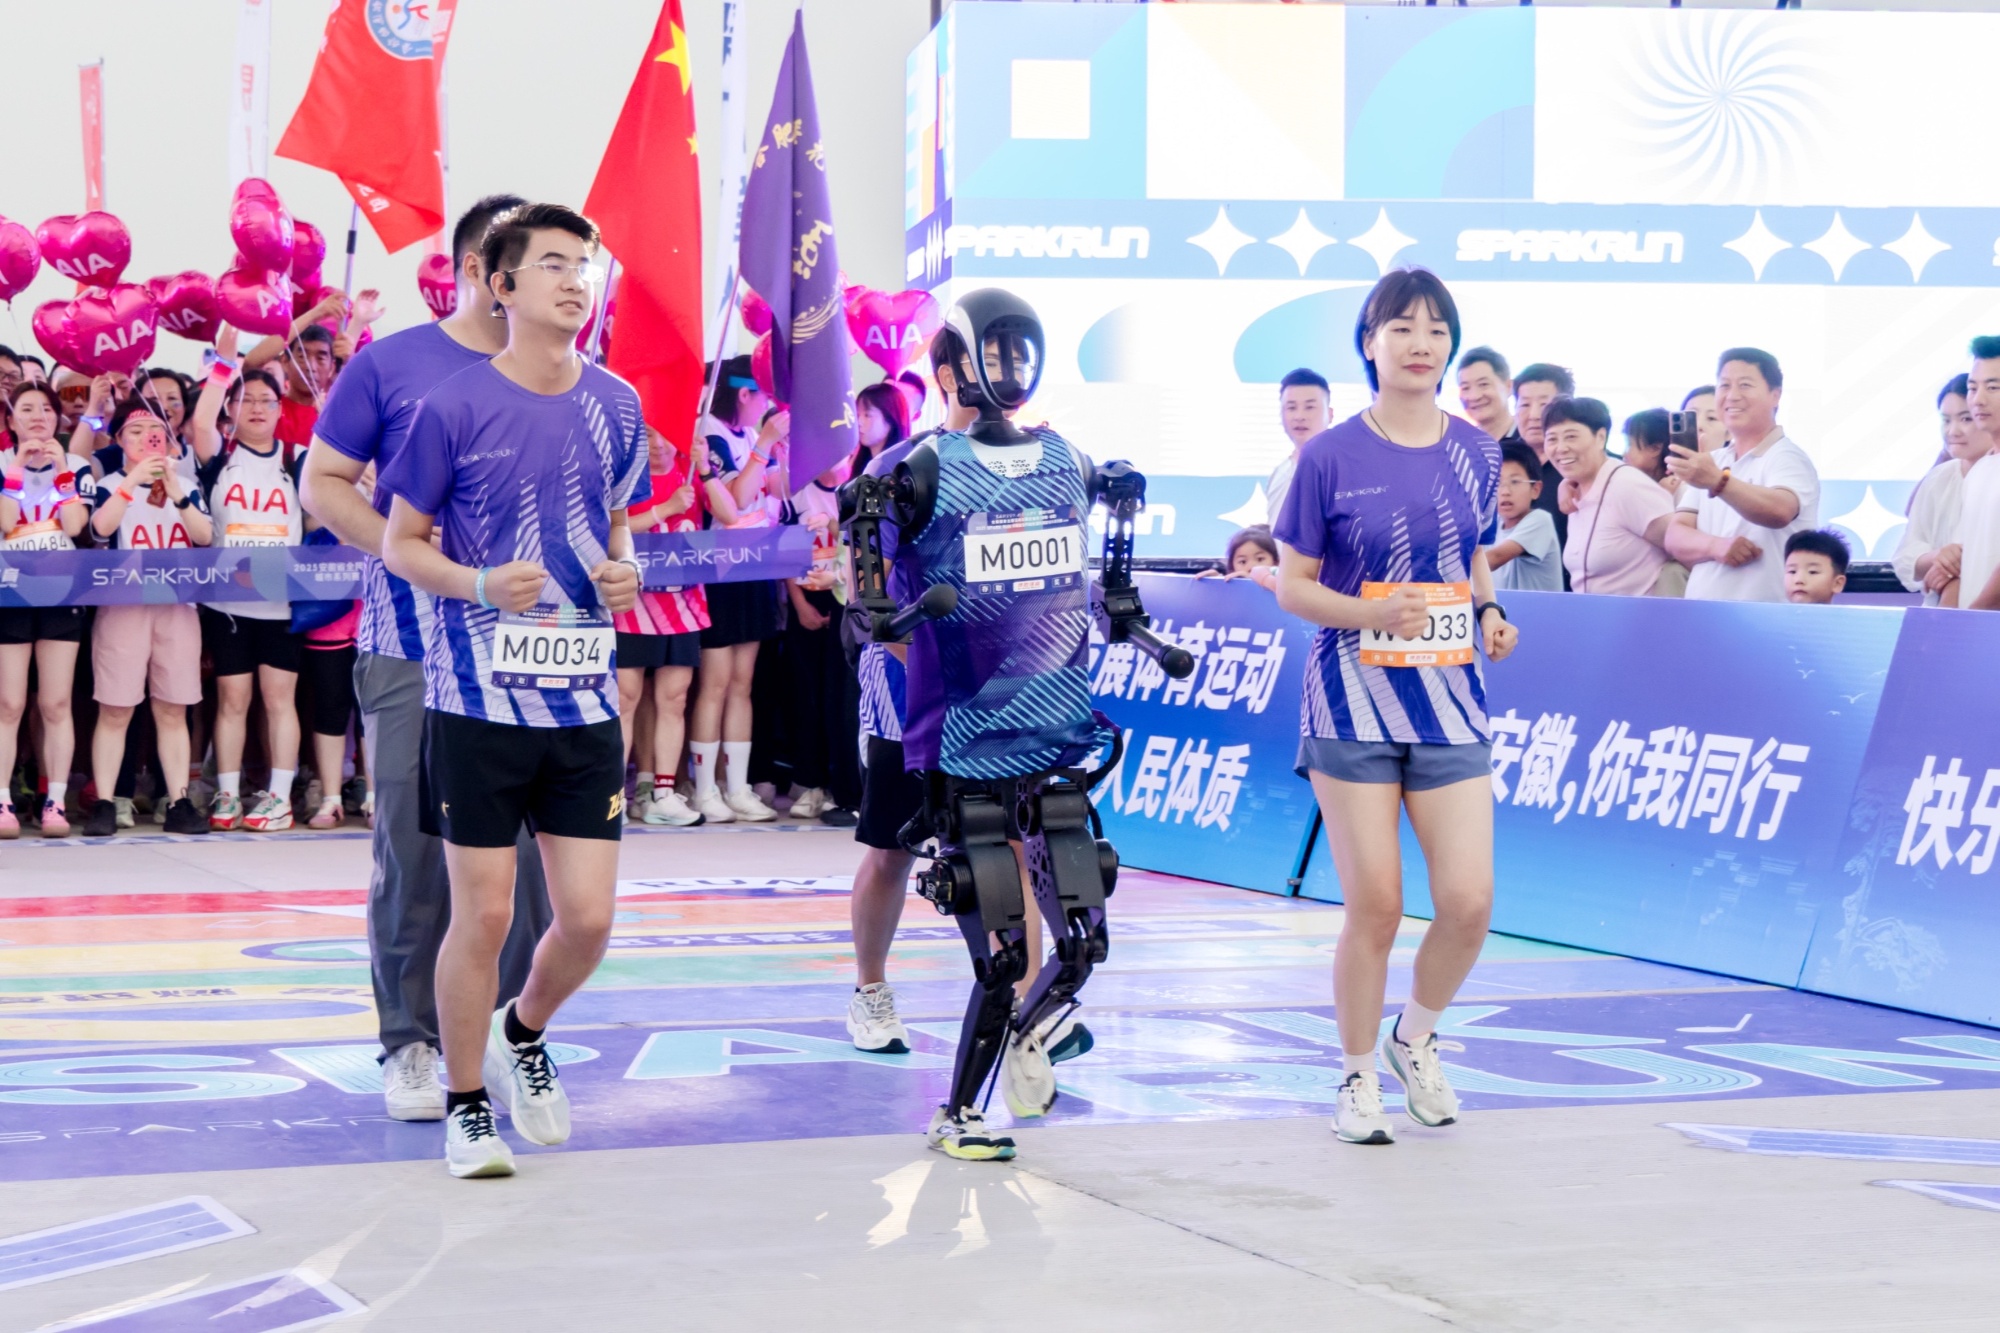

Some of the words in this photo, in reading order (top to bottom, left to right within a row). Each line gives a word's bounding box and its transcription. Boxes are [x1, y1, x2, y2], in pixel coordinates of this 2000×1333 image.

[1456, 229, 1685, 264] SPARKRUN
[56, 253, 115, 278] AIA
[94, 319, 153, 357] AIA
[865, 323, 923, 349] AIA
[224, 483, 288, 515] AIA
[131, 522, 192, 549] AIA
[980, 536, 1070, 572] M0001
[1373, 612, 1467, 641] 033
[502, 634, 601, 665] M0034
[1080, 728, 1250, 833] 人民体质
